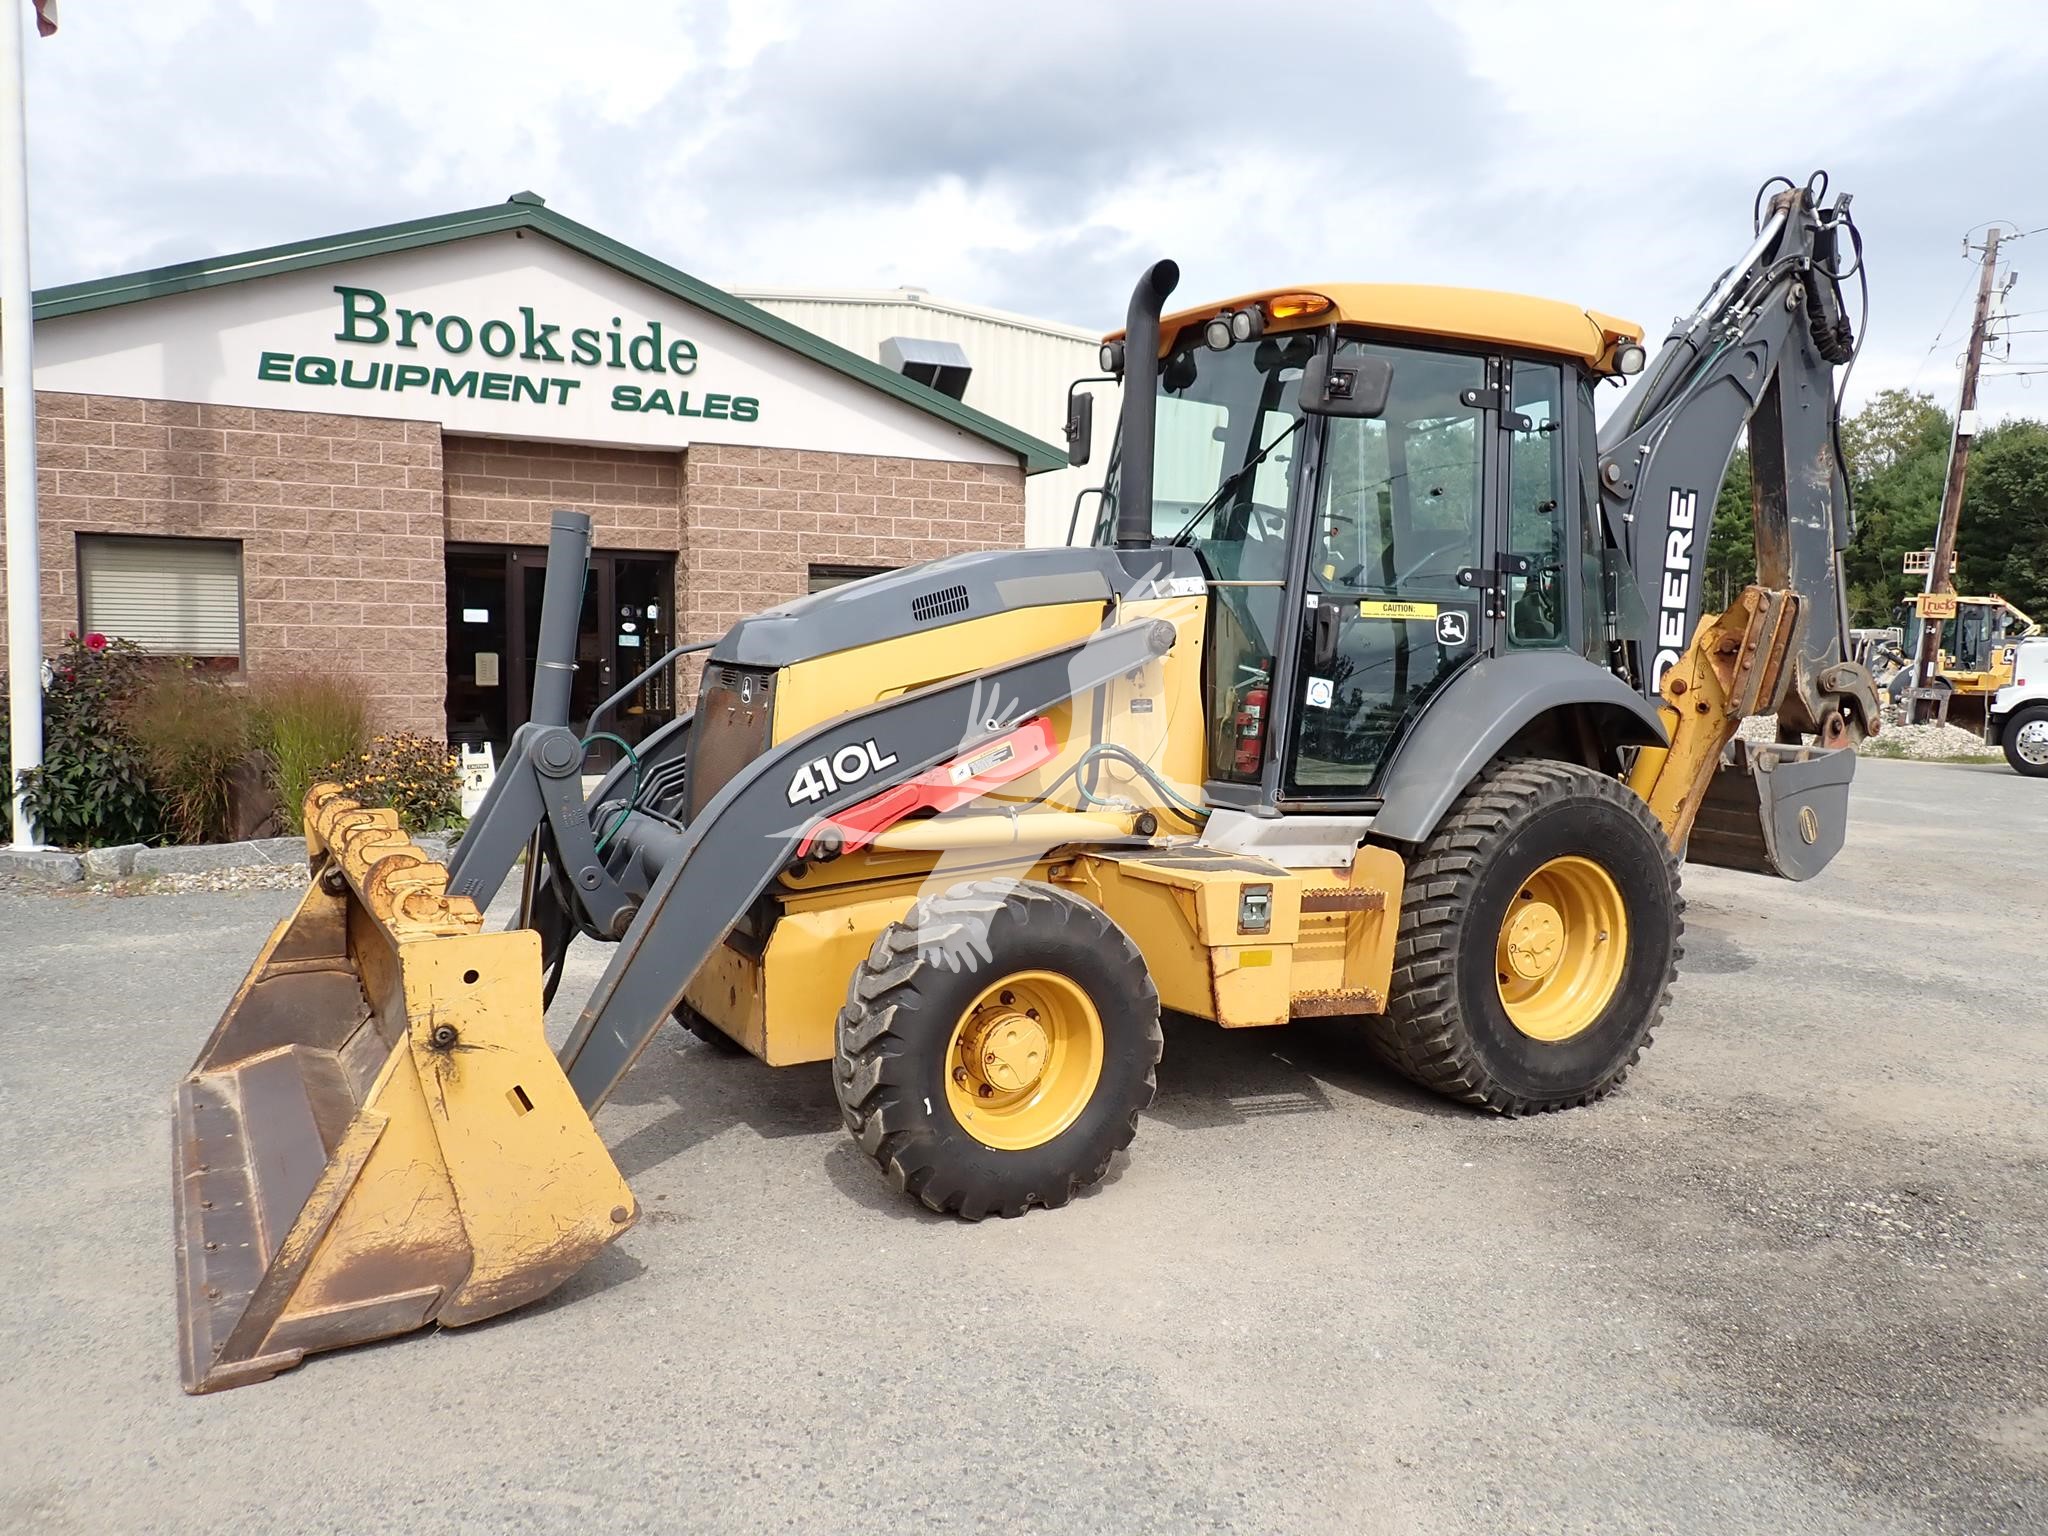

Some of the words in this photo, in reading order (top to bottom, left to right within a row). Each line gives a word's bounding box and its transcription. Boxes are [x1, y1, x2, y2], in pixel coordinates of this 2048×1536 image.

[333, 285, 698, 376] Brookside
[257, 351, 581, 406] EQUIPMENT
[611, 384, 760, 422] SALES
[1918, 595, 1956, 612] Trucks
[786, 738, 899, 806] 410L
